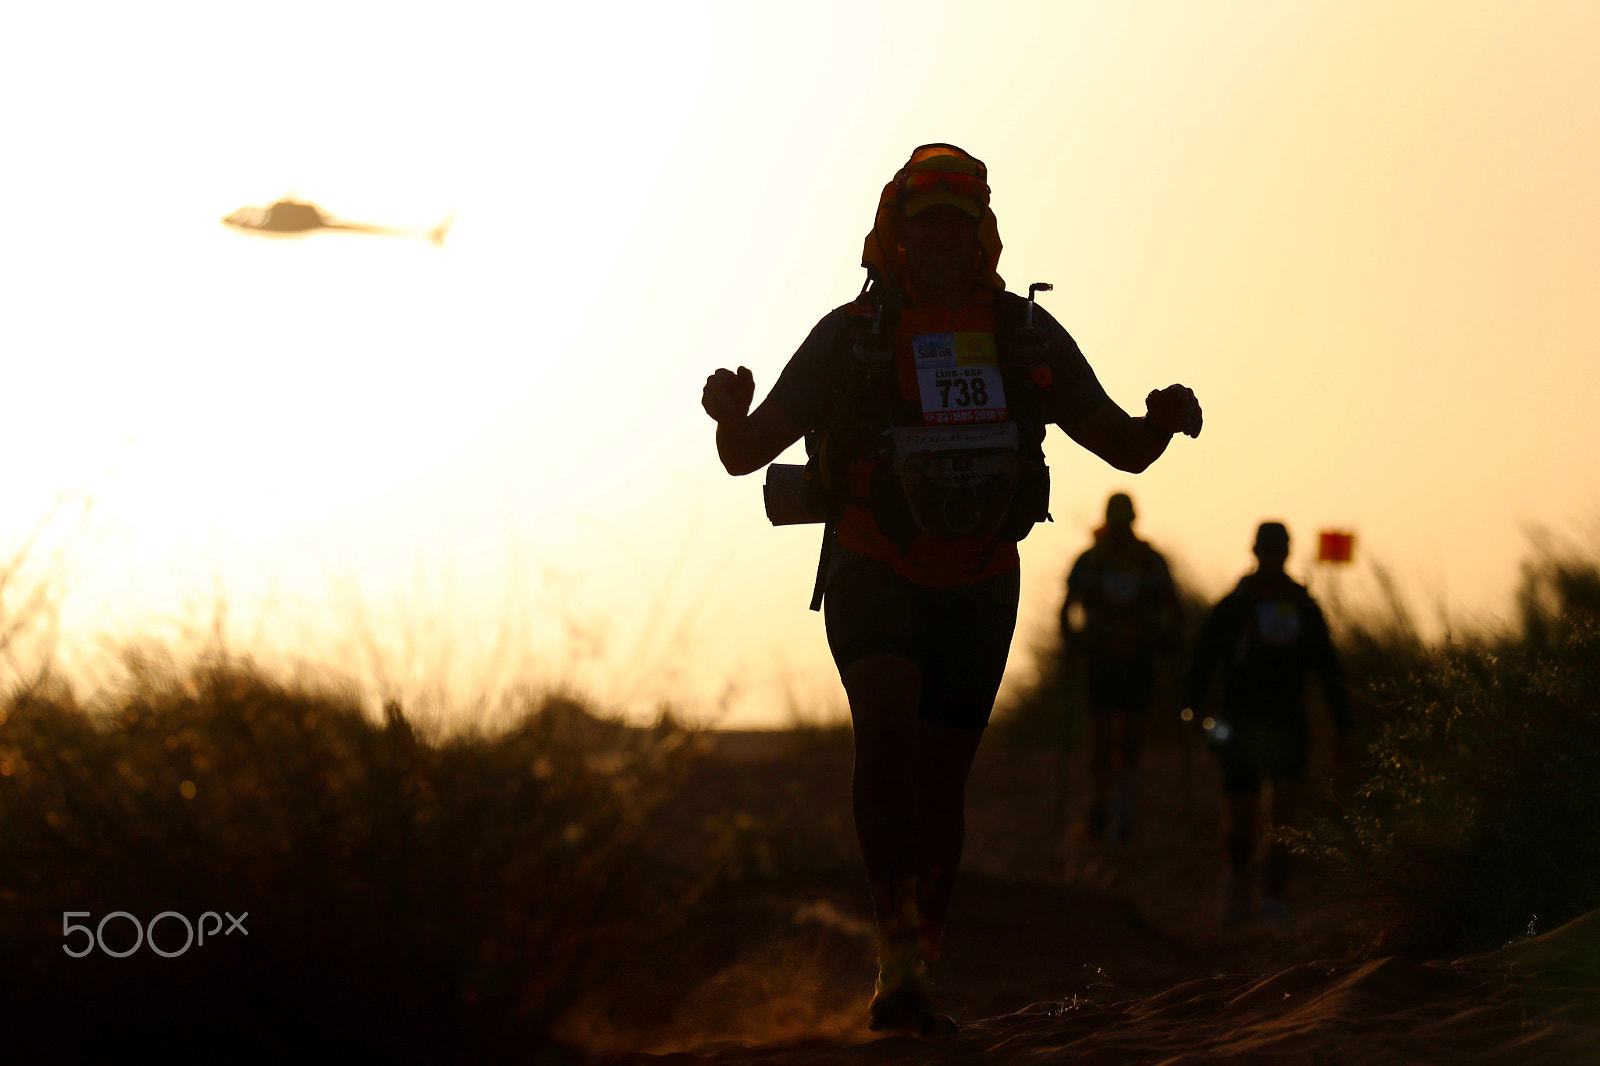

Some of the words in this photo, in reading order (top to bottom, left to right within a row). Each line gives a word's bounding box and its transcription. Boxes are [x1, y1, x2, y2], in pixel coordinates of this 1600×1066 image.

[918, 347, 938, 359] Sidi
[936, 370, 958, 378] LUIS
[964, 369, 983, 377] ESP
[935, 377, 988, 408] 738
[953, 411, 973, 421] MDS
[974, 410, 996, 420] 2018
